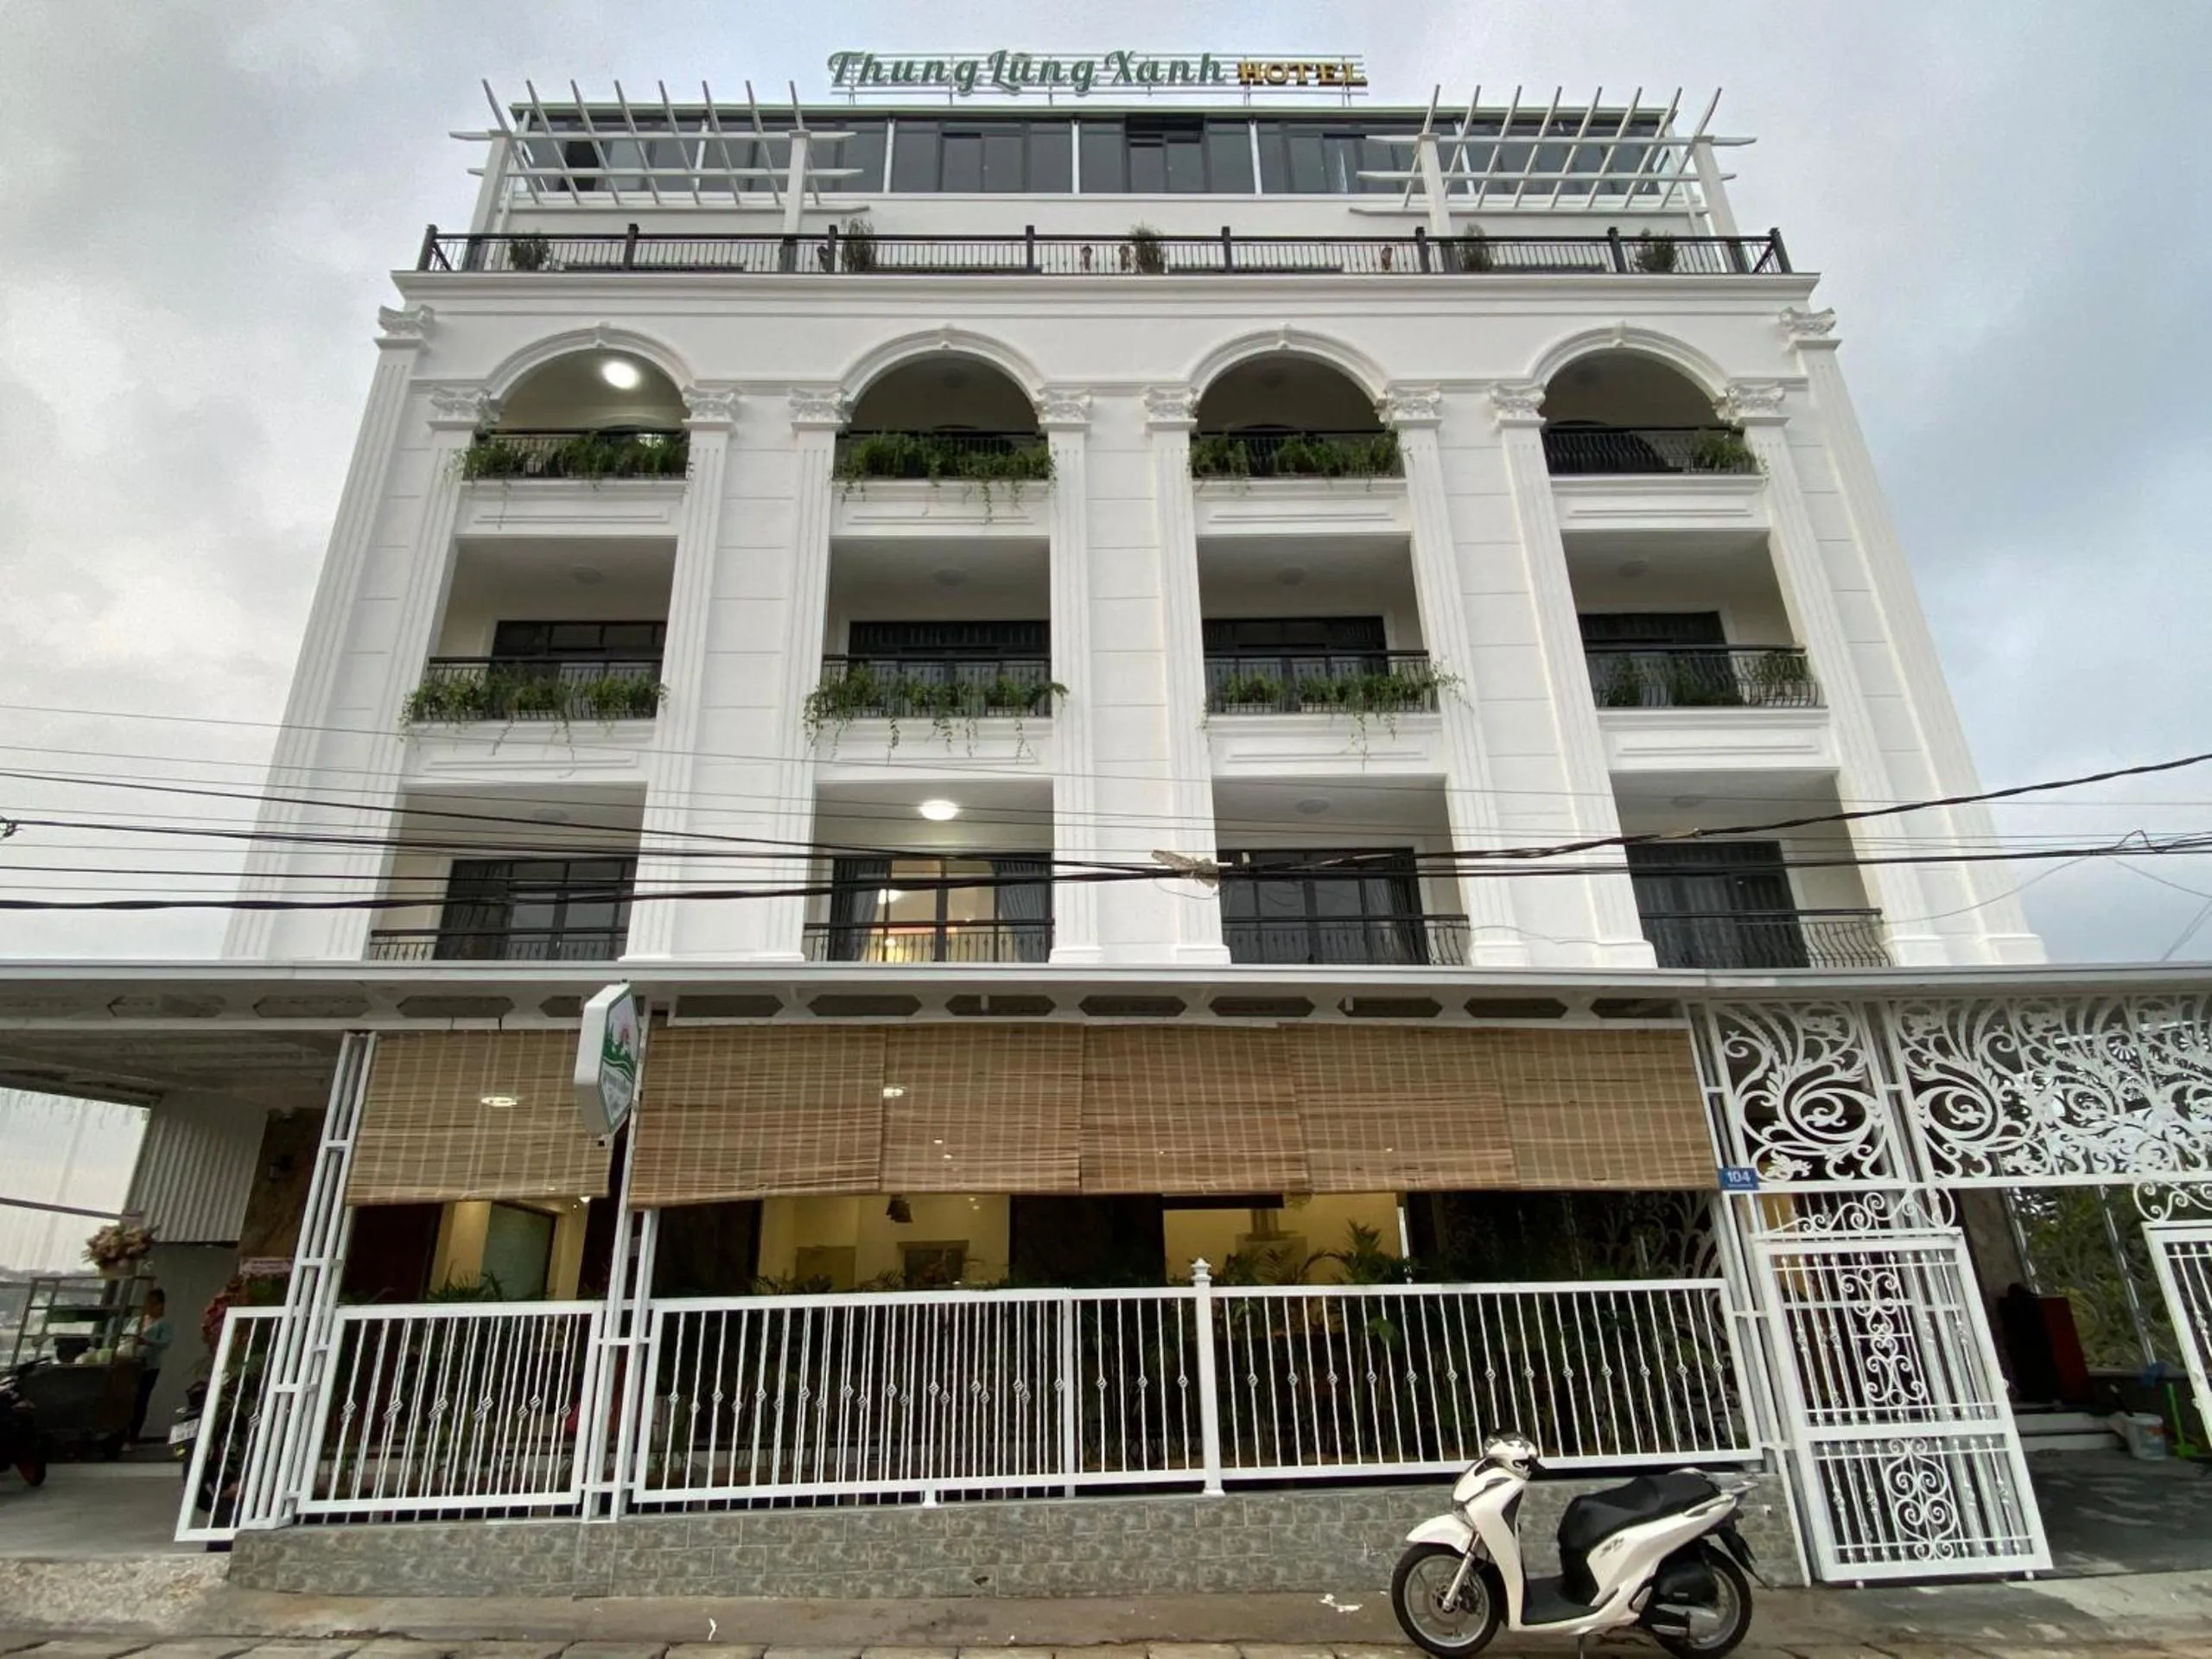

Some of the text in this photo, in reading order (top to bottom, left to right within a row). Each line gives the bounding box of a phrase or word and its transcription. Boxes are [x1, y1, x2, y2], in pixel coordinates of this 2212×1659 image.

[827, 51, 982, 97] Thung
[1104, 50, 1230, 86] Xanh
[1236, 61, 1368, 86] HOTEL
[1727, 1170, 1751, 1183] 104
